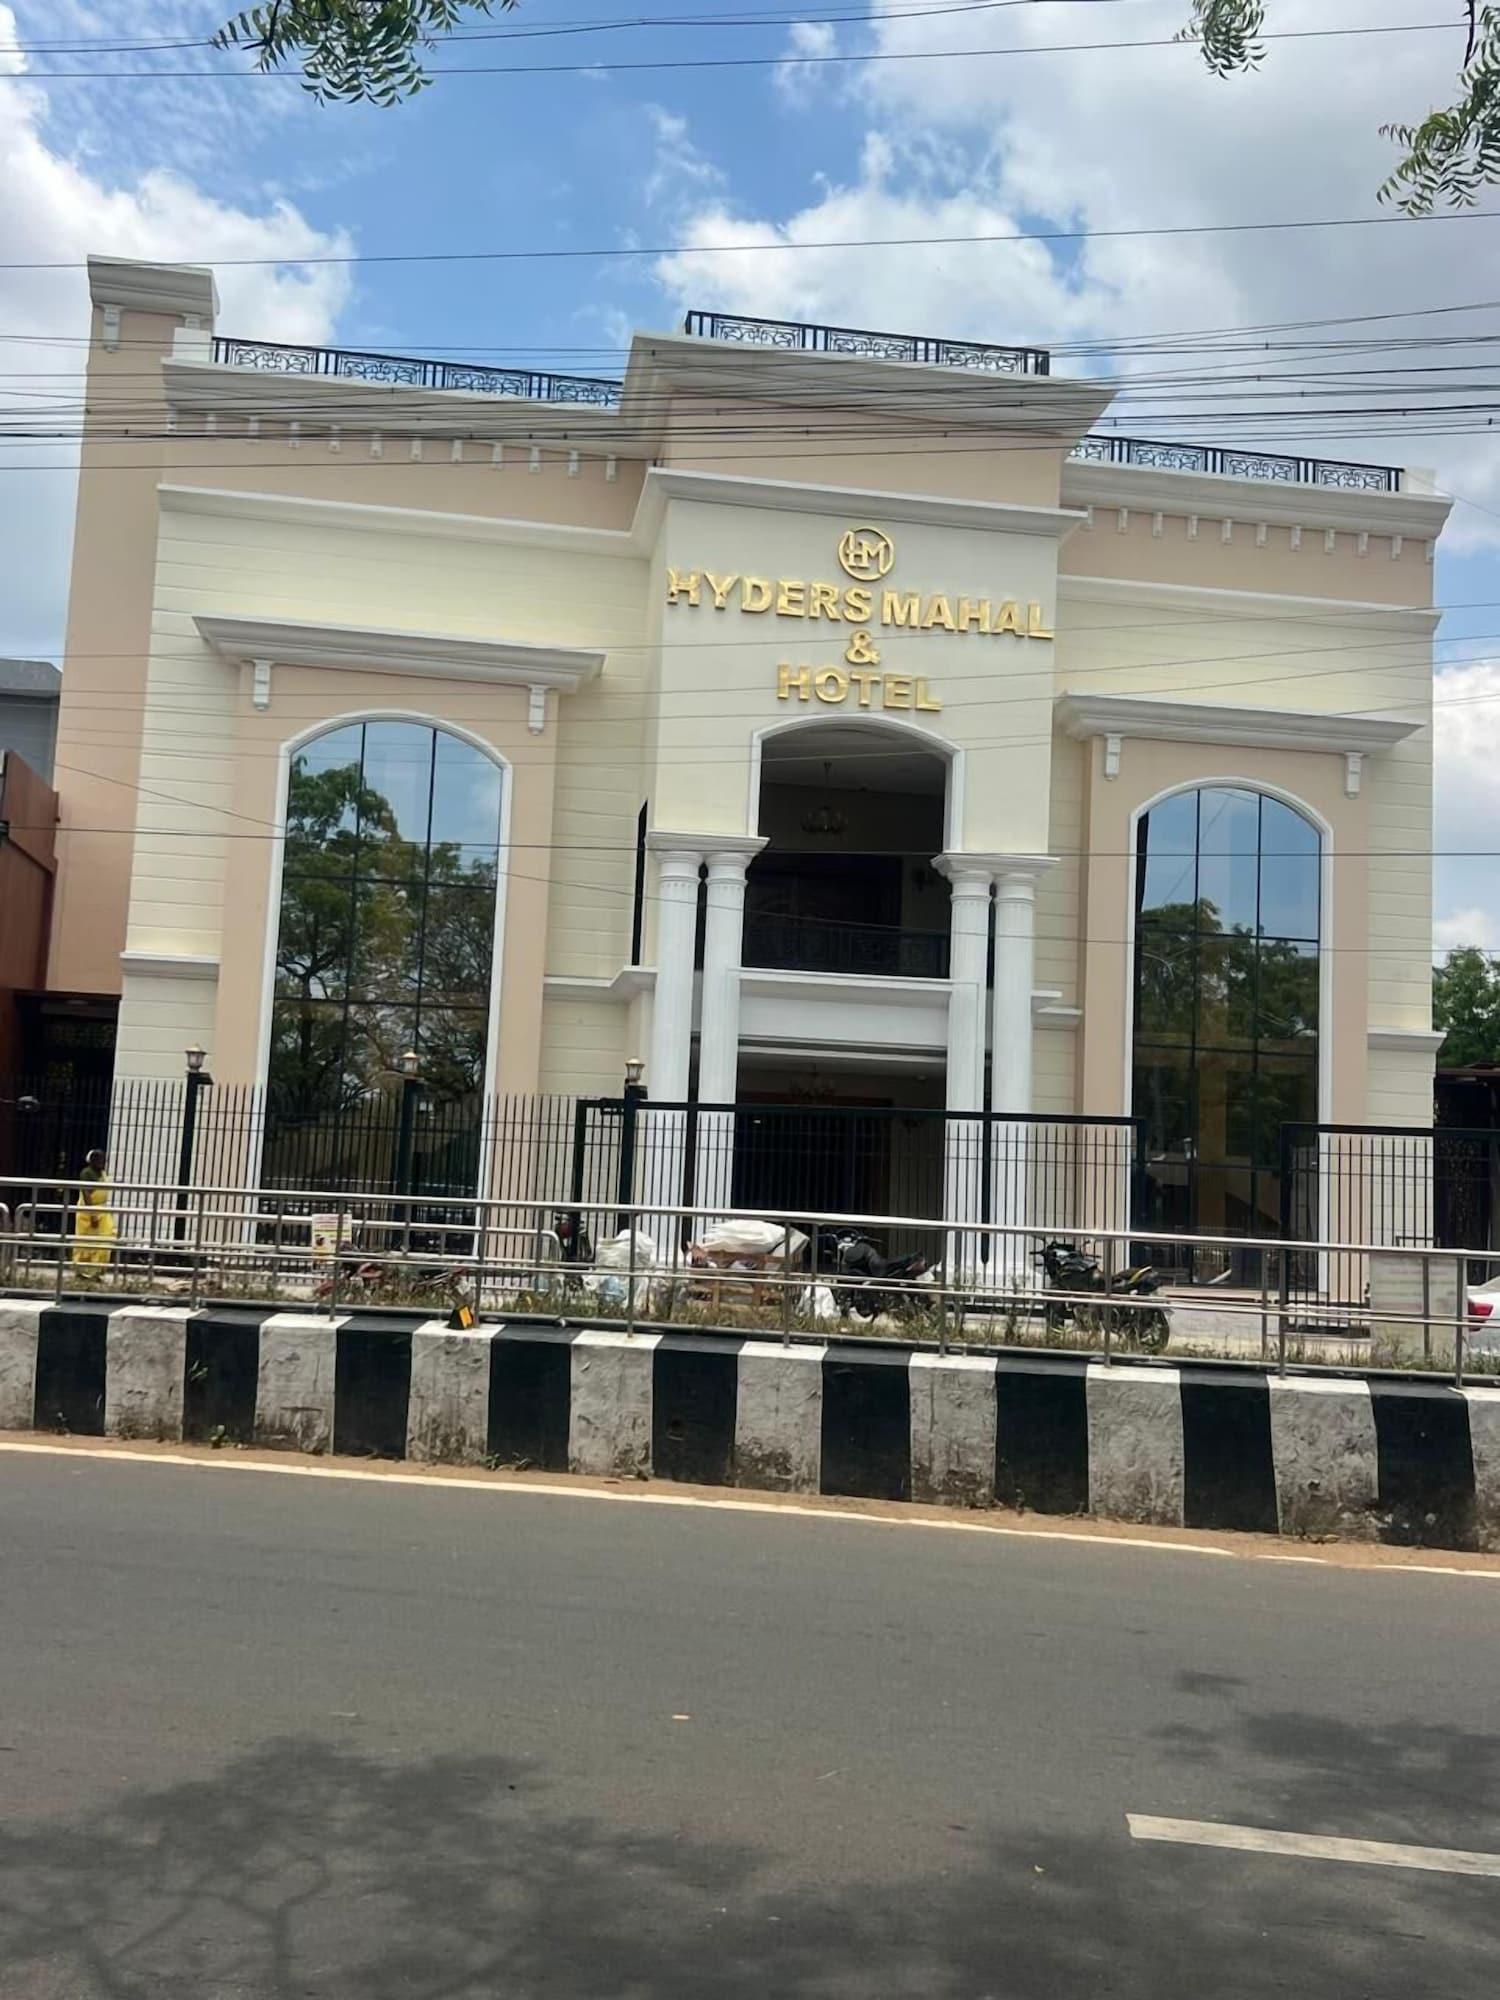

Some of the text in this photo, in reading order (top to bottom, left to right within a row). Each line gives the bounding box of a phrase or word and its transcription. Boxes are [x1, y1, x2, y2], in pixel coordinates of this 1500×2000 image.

[667, 568, 1054, 639] HYDERS MAHAL
[846, 631, 880, 664] &
[777, 664, 942, 711] HOTEL
